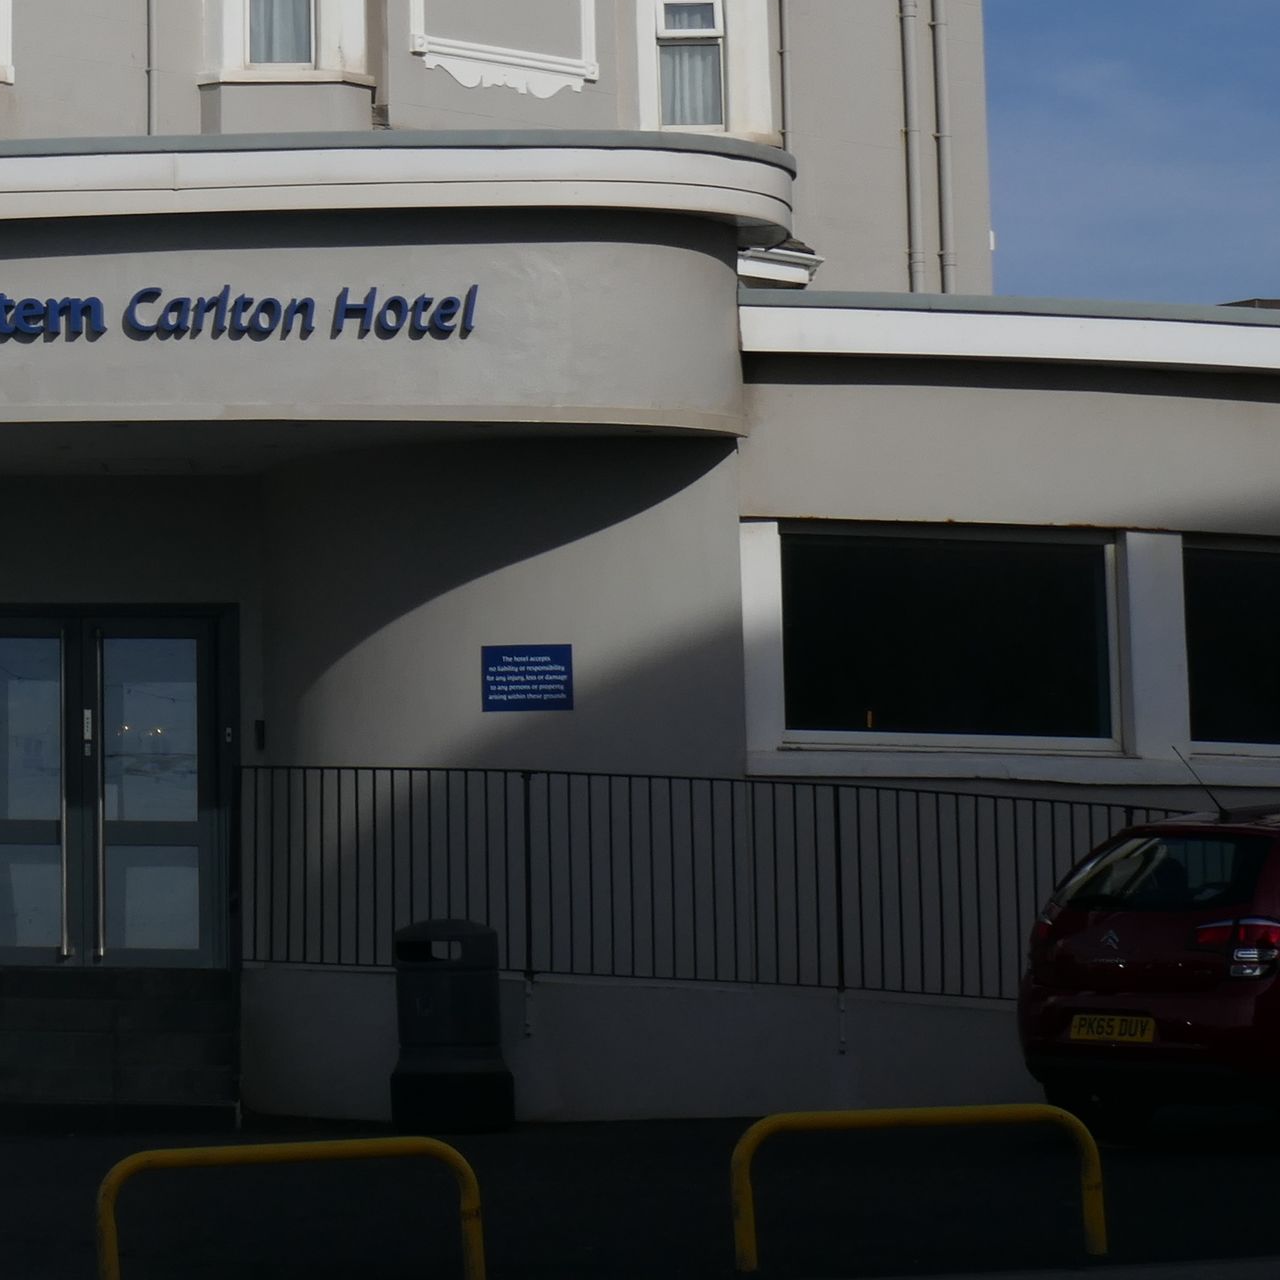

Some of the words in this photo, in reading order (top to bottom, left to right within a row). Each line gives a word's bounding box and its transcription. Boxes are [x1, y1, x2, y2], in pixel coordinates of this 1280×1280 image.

[125, 284, 315, 334] Carlton
[334, 284, 479, 335] Hotel
[1078, 1017, 1116, 1037] PK65
